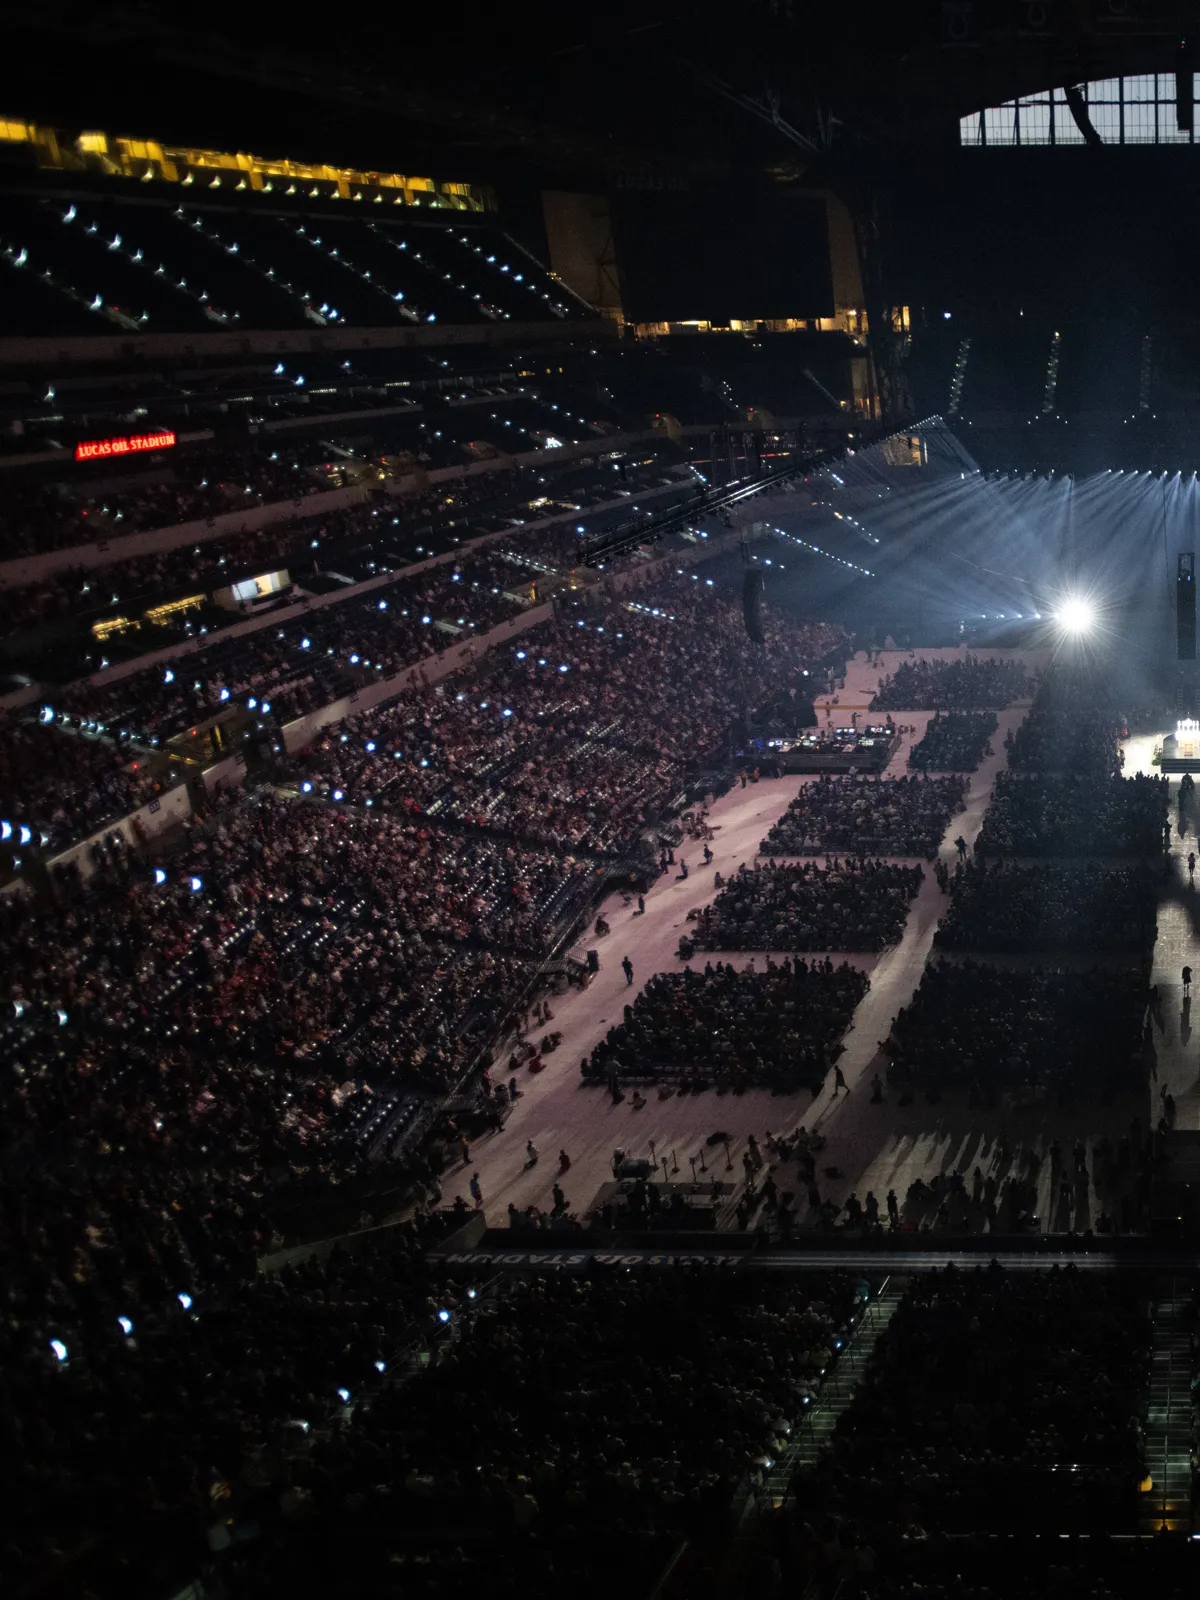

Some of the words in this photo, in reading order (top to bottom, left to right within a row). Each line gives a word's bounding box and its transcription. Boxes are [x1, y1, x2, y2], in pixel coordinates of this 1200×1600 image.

[78, 442, 111, 458] LUCAS
[112, 440, 129, 453] OIL
[131, 433, 175, 450] STADIUM
[446, 1253, 587, 1267] STADIUM
